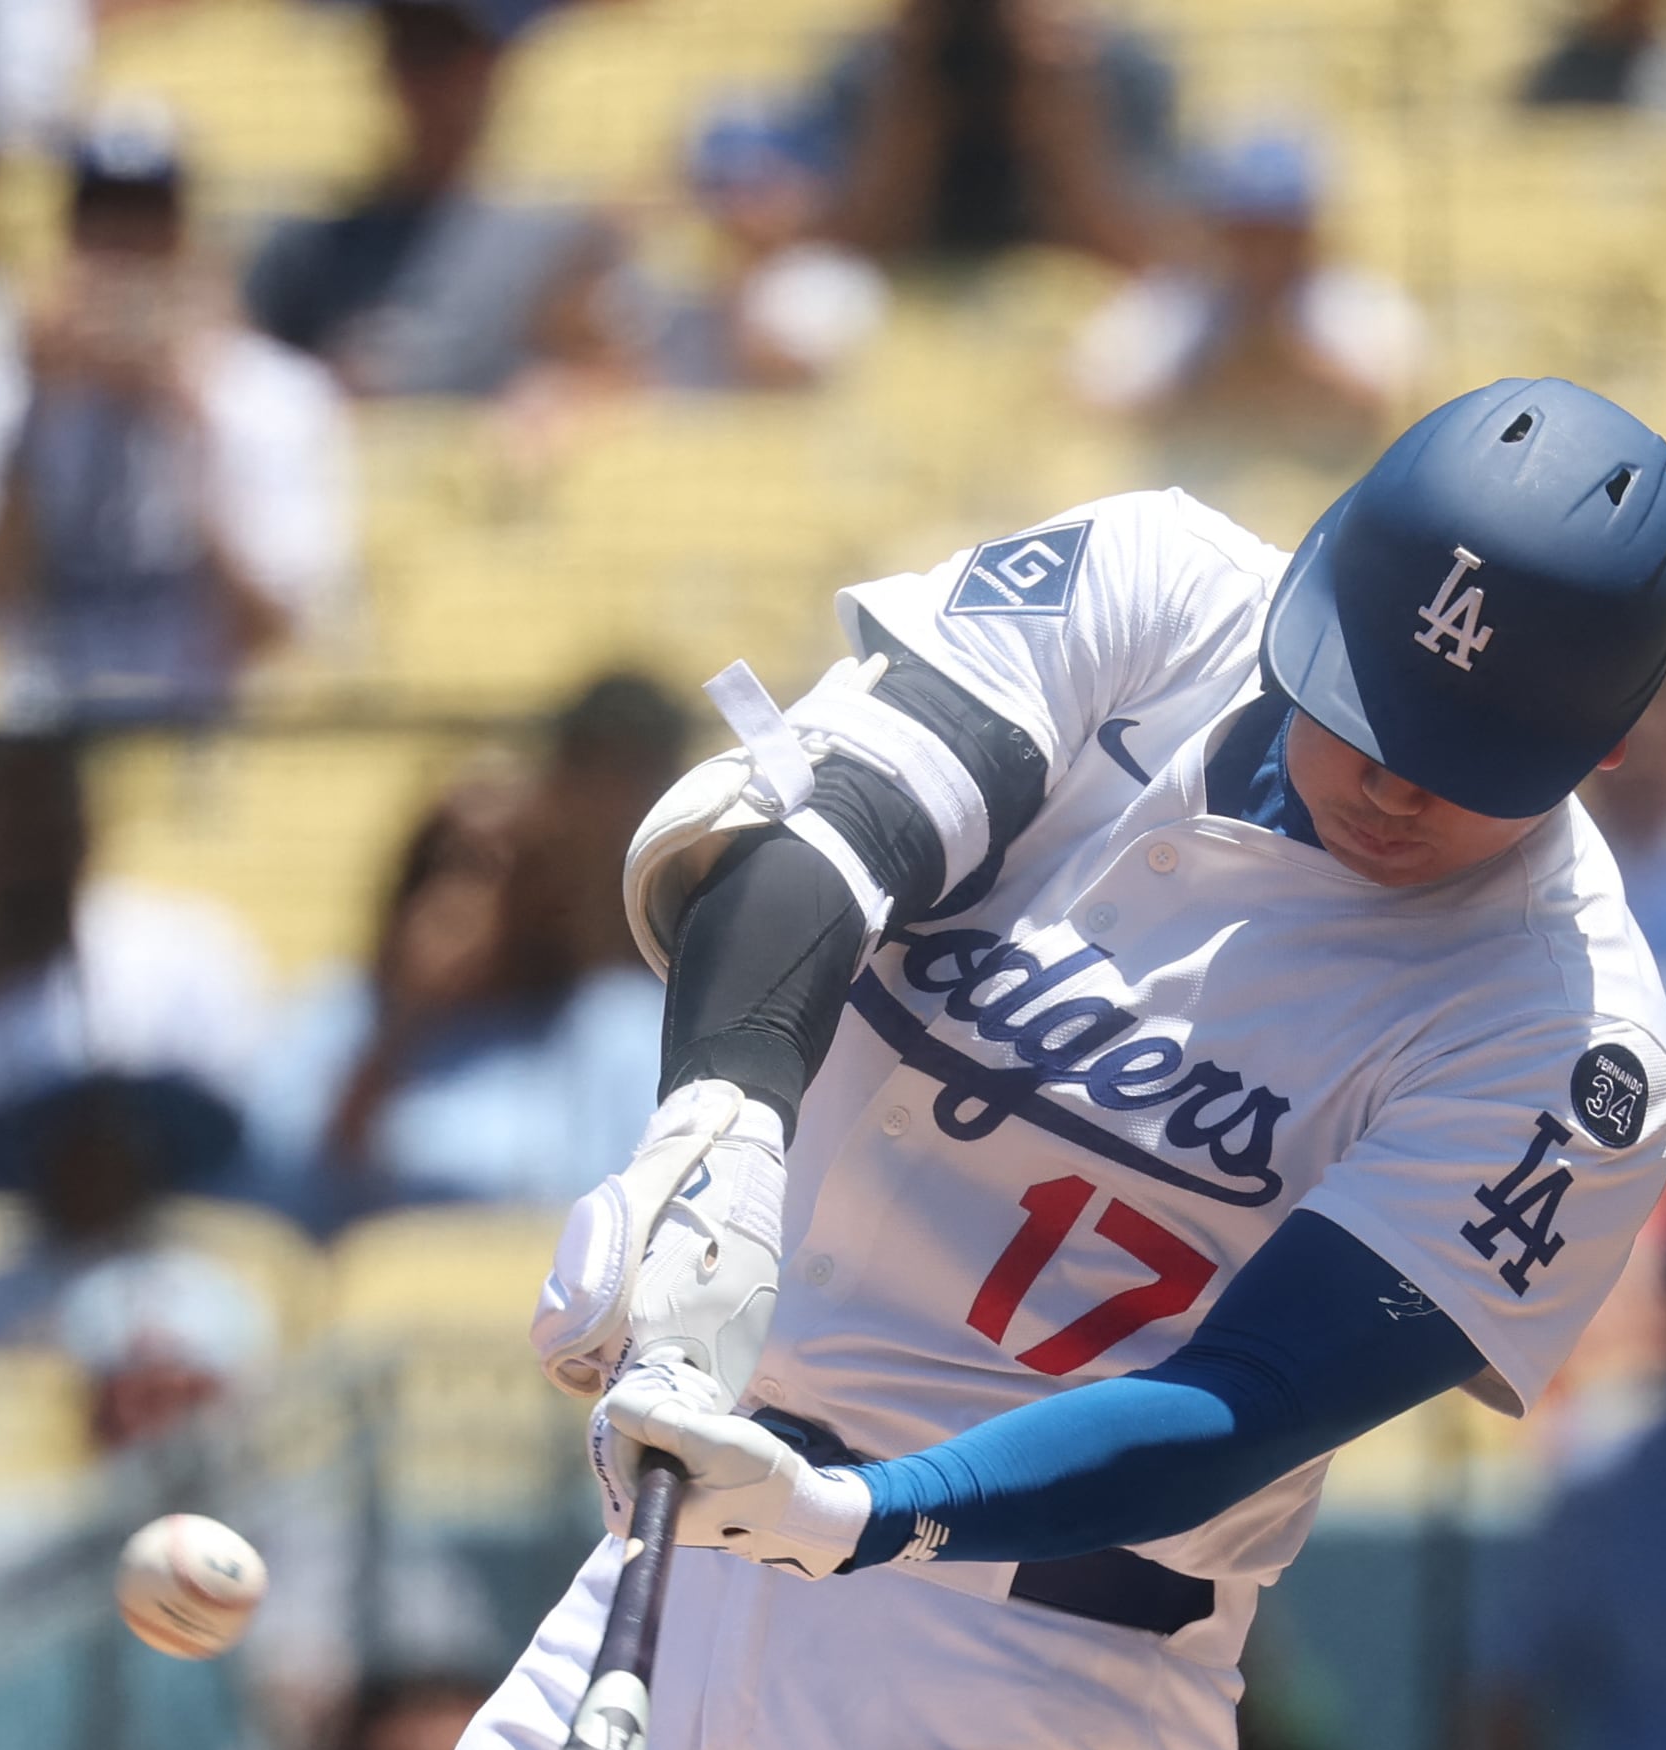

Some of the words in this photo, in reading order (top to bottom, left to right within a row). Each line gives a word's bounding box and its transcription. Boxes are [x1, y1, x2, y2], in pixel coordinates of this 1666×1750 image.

[996, 540, 1065, 588] G
[1414, 546, 1493, 672] LA
[1585, 1074, 1637, 1135] 34
[1595, 1054, 1643, 1095] FERNANDO
[1459, 1110, 1574, 1298] LA
[966, 1174, 1219, 1376] 17
[614, 1336, 633, 1375] new
[592, 1436, 621, 1514] balance
